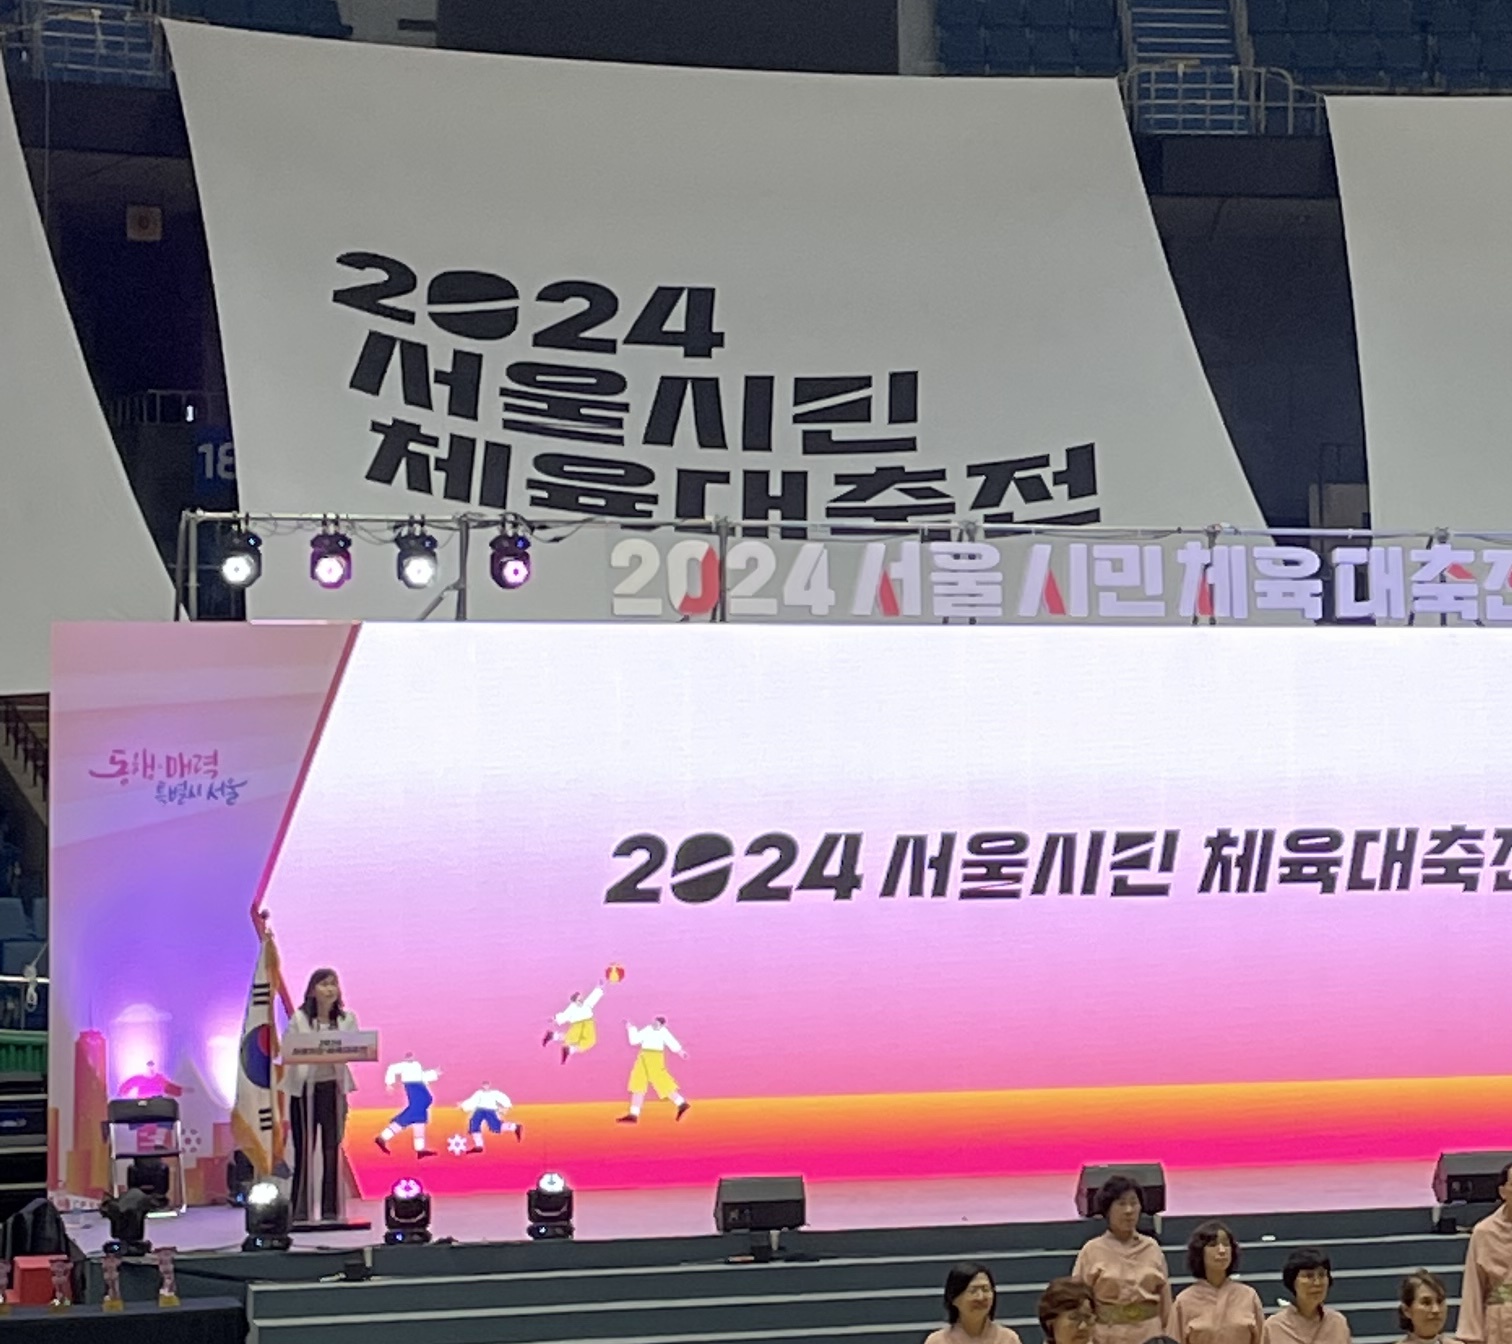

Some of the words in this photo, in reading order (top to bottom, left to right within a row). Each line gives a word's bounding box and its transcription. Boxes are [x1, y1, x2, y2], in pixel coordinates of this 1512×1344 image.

[333, 252, 725, 358] 2024
[349, 329, 919, 455] 서울시민
[610, 538, 836, 617] 2024
[603, 830, 864, 905] 2024
[878, 829, 1181, 901] 서울시민
